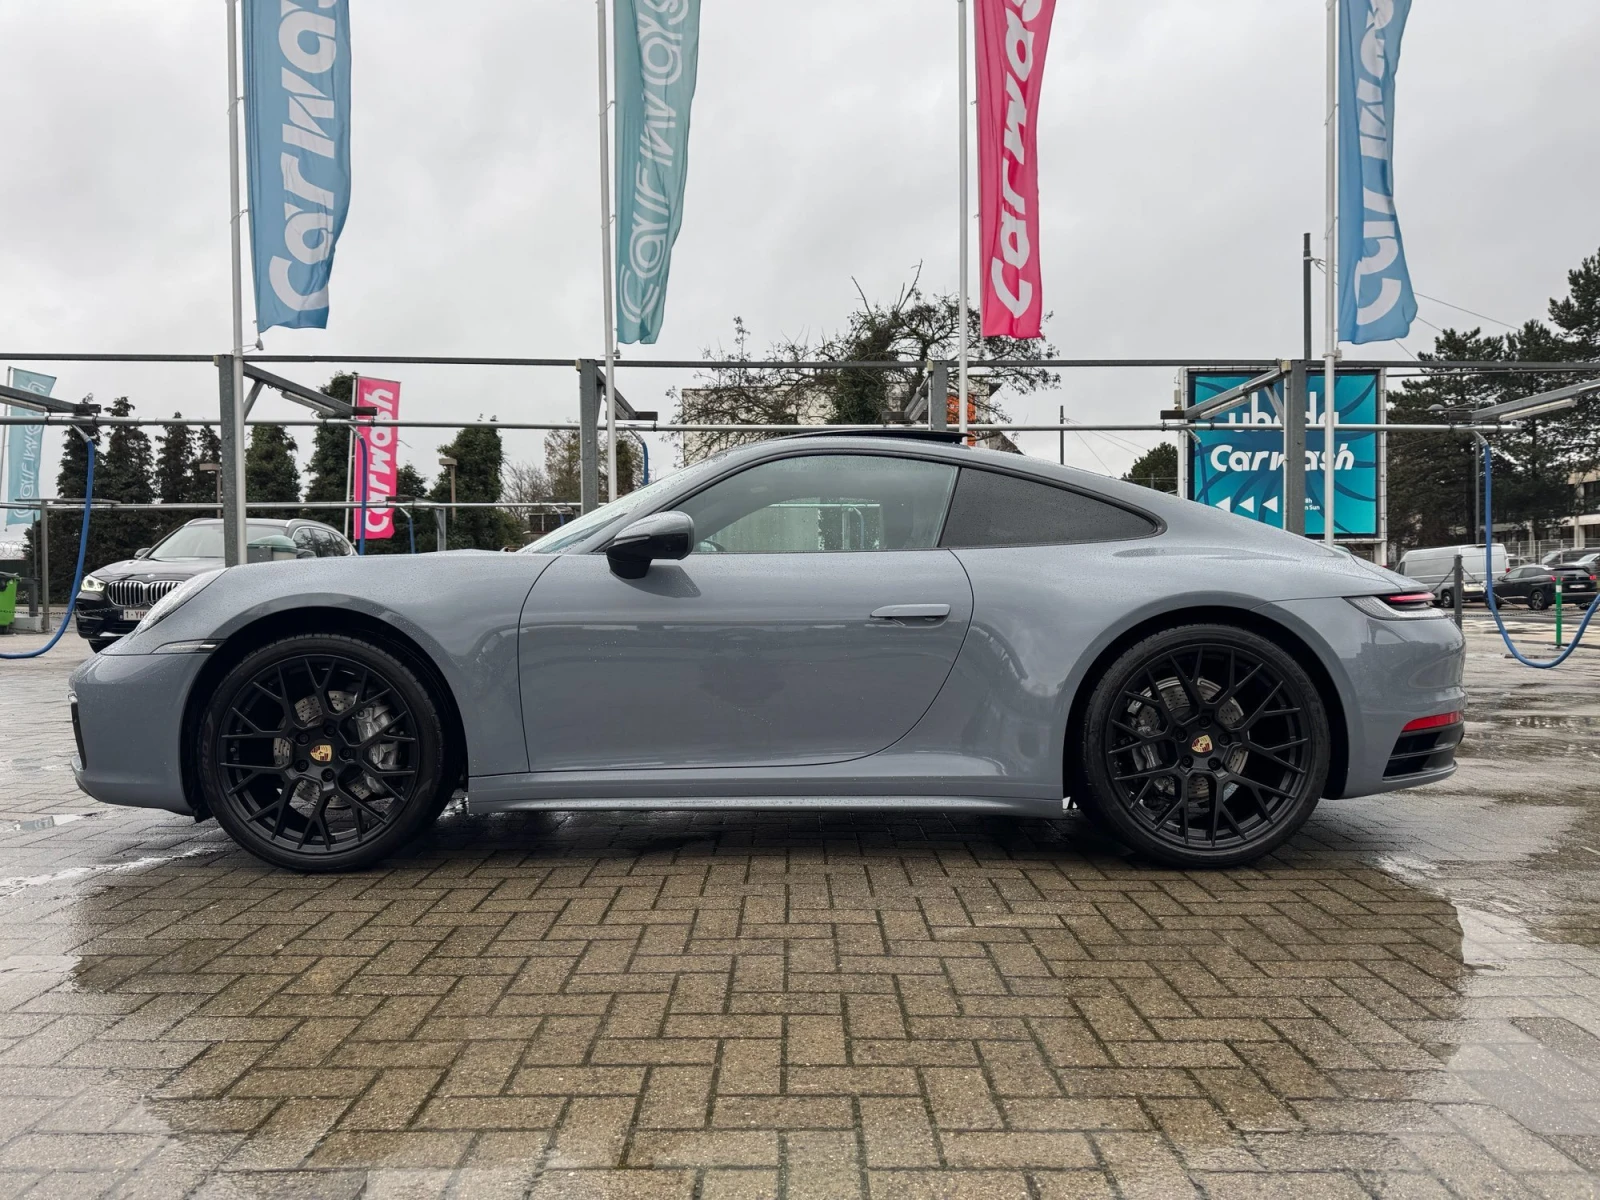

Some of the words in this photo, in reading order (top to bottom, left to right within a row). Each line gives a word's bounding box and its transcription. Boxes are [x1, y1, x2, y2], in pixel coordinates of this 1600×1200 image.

[269, 0, 337, 311] Carwa
[14, 381, 47, 518] Carwah
[1228, 391, 1340, 433] ubd
